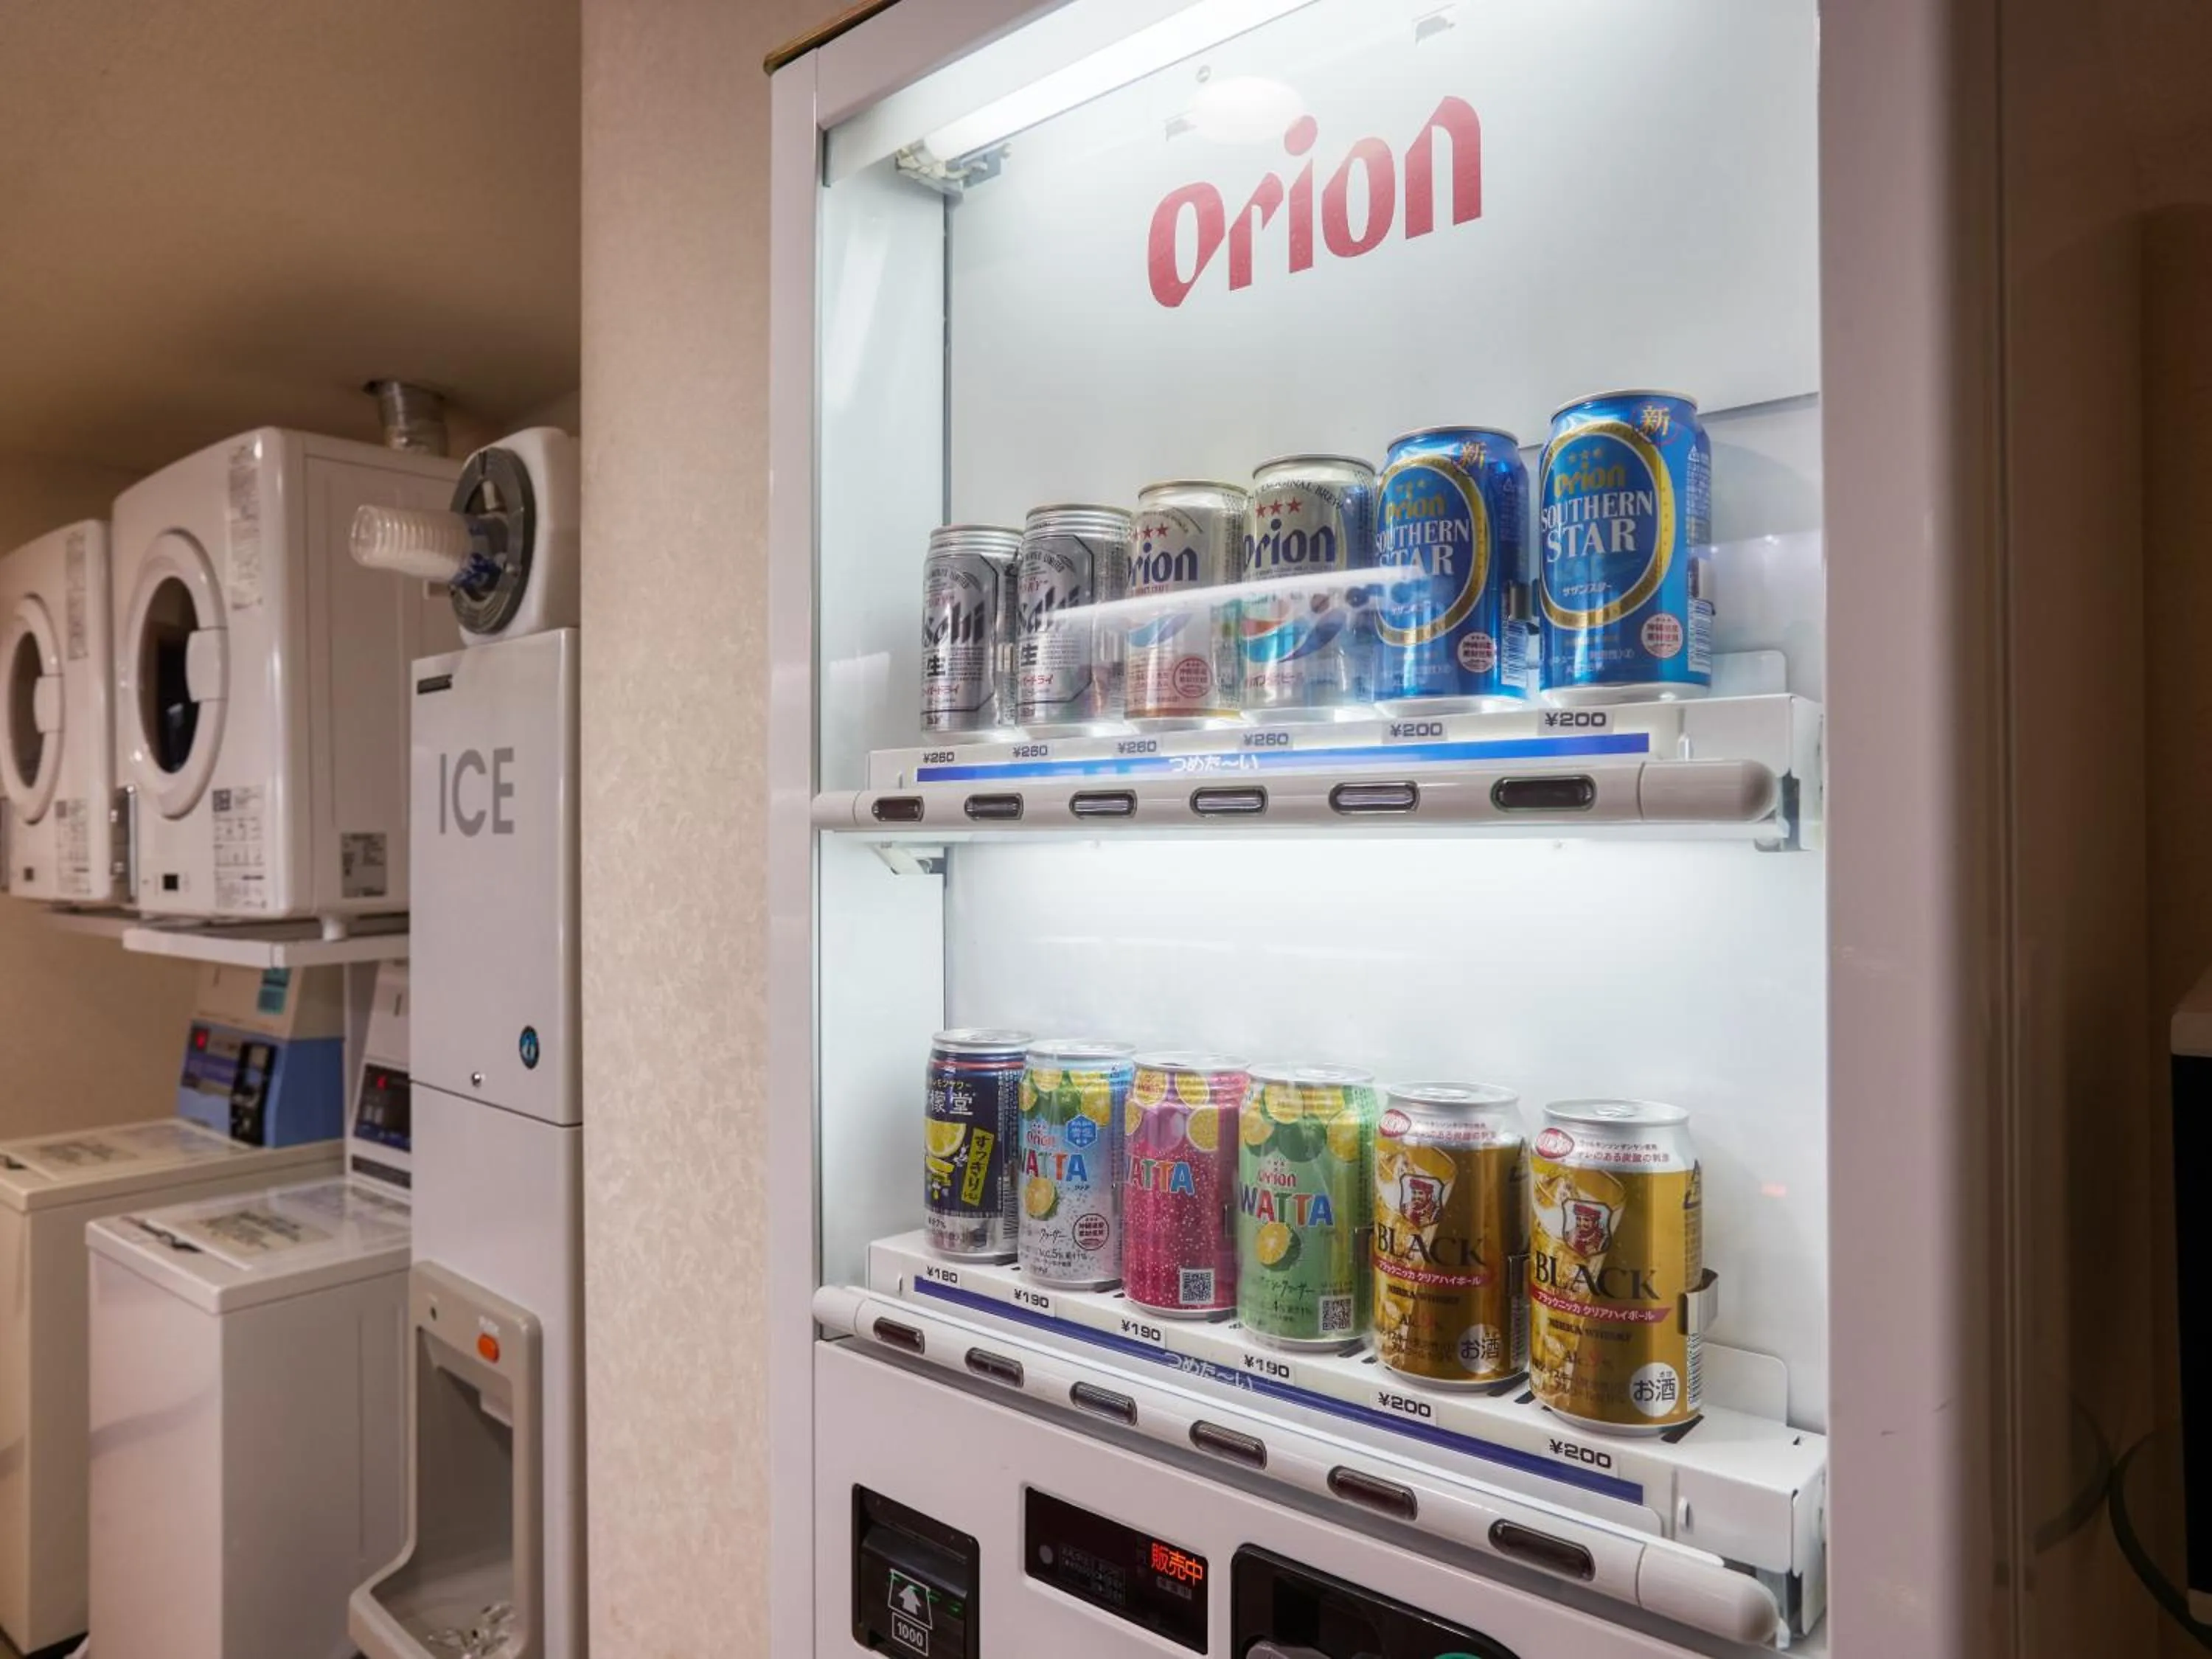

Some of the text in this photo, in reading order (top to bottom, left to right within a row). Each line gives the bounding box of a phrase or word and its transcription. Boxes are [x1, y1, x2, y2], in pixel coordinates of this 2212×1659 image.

[1147, 95, 1482, 308] orion
[1641, 406, 1670, 436] 新
[1554, 462, 1627, 498] orion
[1386, 490, 1445, 524] orion
[1541, 490, 1653, 532] SOUTHERN
[1243, 518, 1336, 574] orion
[1376, 518, 1470, 554] SOUTHERN
[1547, 518, 1637, 563] STAR
[1127, 542, 1198, 589] rion
[922, 601, 985, 648] sahi
[928, 655, 946, 677] 生
[1390, 722, 1444, 738] ¥200
[1545, 712, 1607, 728] ¥200
[1012, 745, 1048, 758] ¥260
[1118, 740, 1158, 754] ¥260
[1243, 732, 1290, 748] ¥260
[922, 751, 955, 764] ¥260
[439, 747, 515, 838] ICE
[929, 1089, 974, 1116] 檬堂
[1124, 1154, 1194, 1196] ATTA
[1239, 1180, 1335, 1227] WATTA
[1376, 1222, 1486, 1267] BLACK
[926, 1265, 958, 1284] ¥180
[1535, 1250, 1661, 1300] BLACK
[1014, 1288, 1049, 1309] ¥190
[1121, 1319, 1161, 1342] ¥190
[1461, 1338, 1499, 1360] お酒
[1244, 1354, 1290, 1379] ¥190
[1632, 1377, 1677, 1402] お酒
[1378, 1391, 1432, 1419] ¥200
[1549, 1438, 1613, 1469] ¥200
[1151, 1542, 1203, 1585] 販売中
[897, 1621, 924, 1647] 1000
